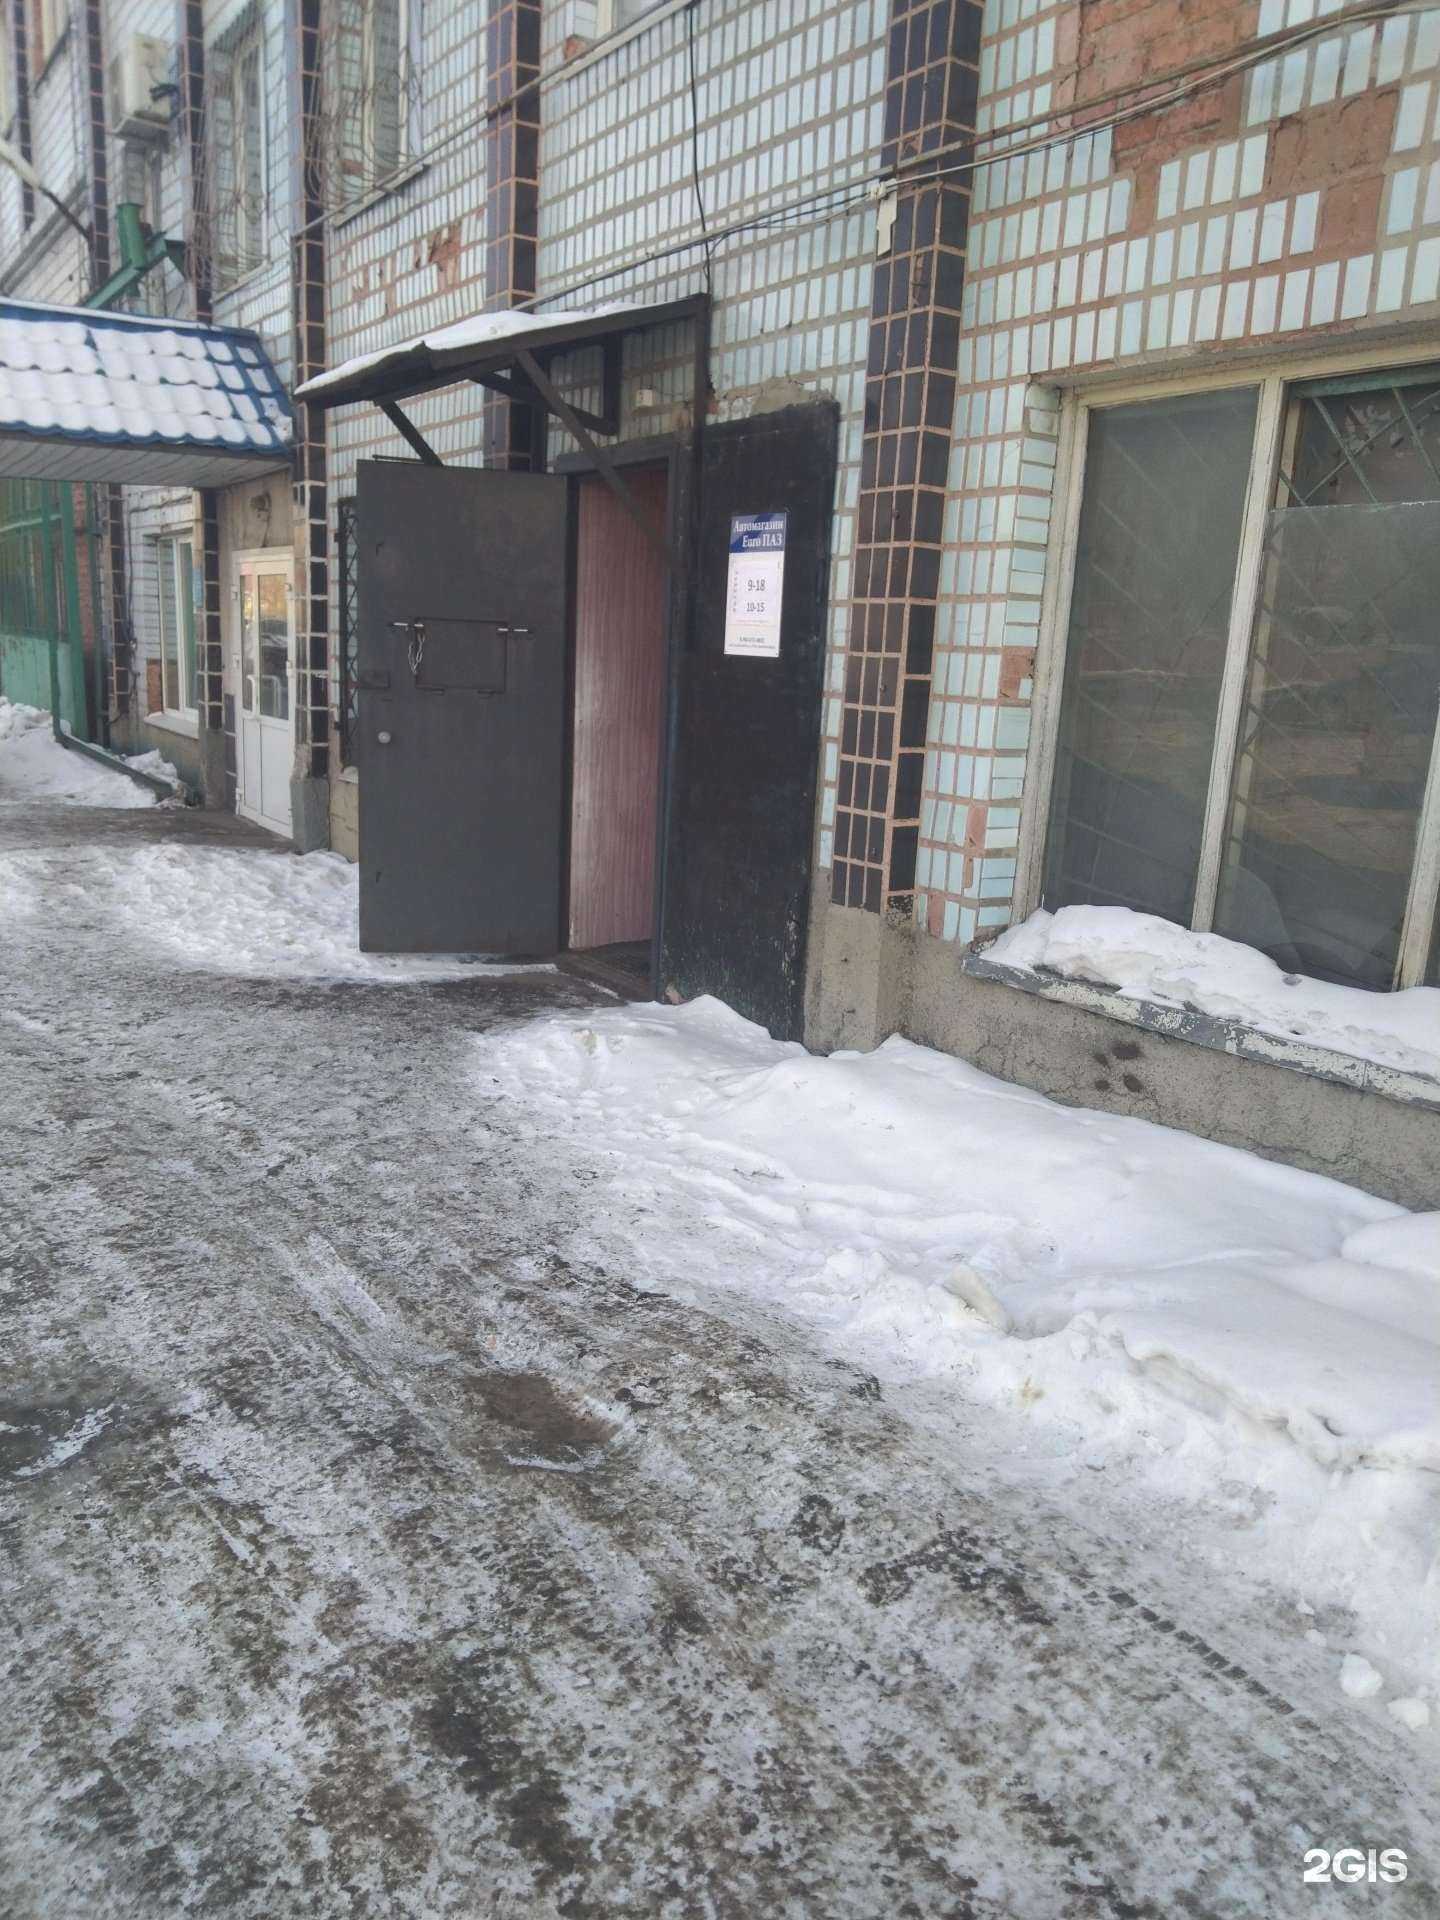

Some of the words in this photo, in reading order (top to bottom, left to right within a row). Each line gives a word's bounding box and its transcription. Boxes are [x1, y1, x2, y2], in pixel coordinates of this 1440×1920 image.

[734, 520, 784, 532] Автомагазин
[762, 533, 783, 547] ПАЗ
[747, 579, 766, 591] 9-18
[746, 602, 765, 613] 10-15
